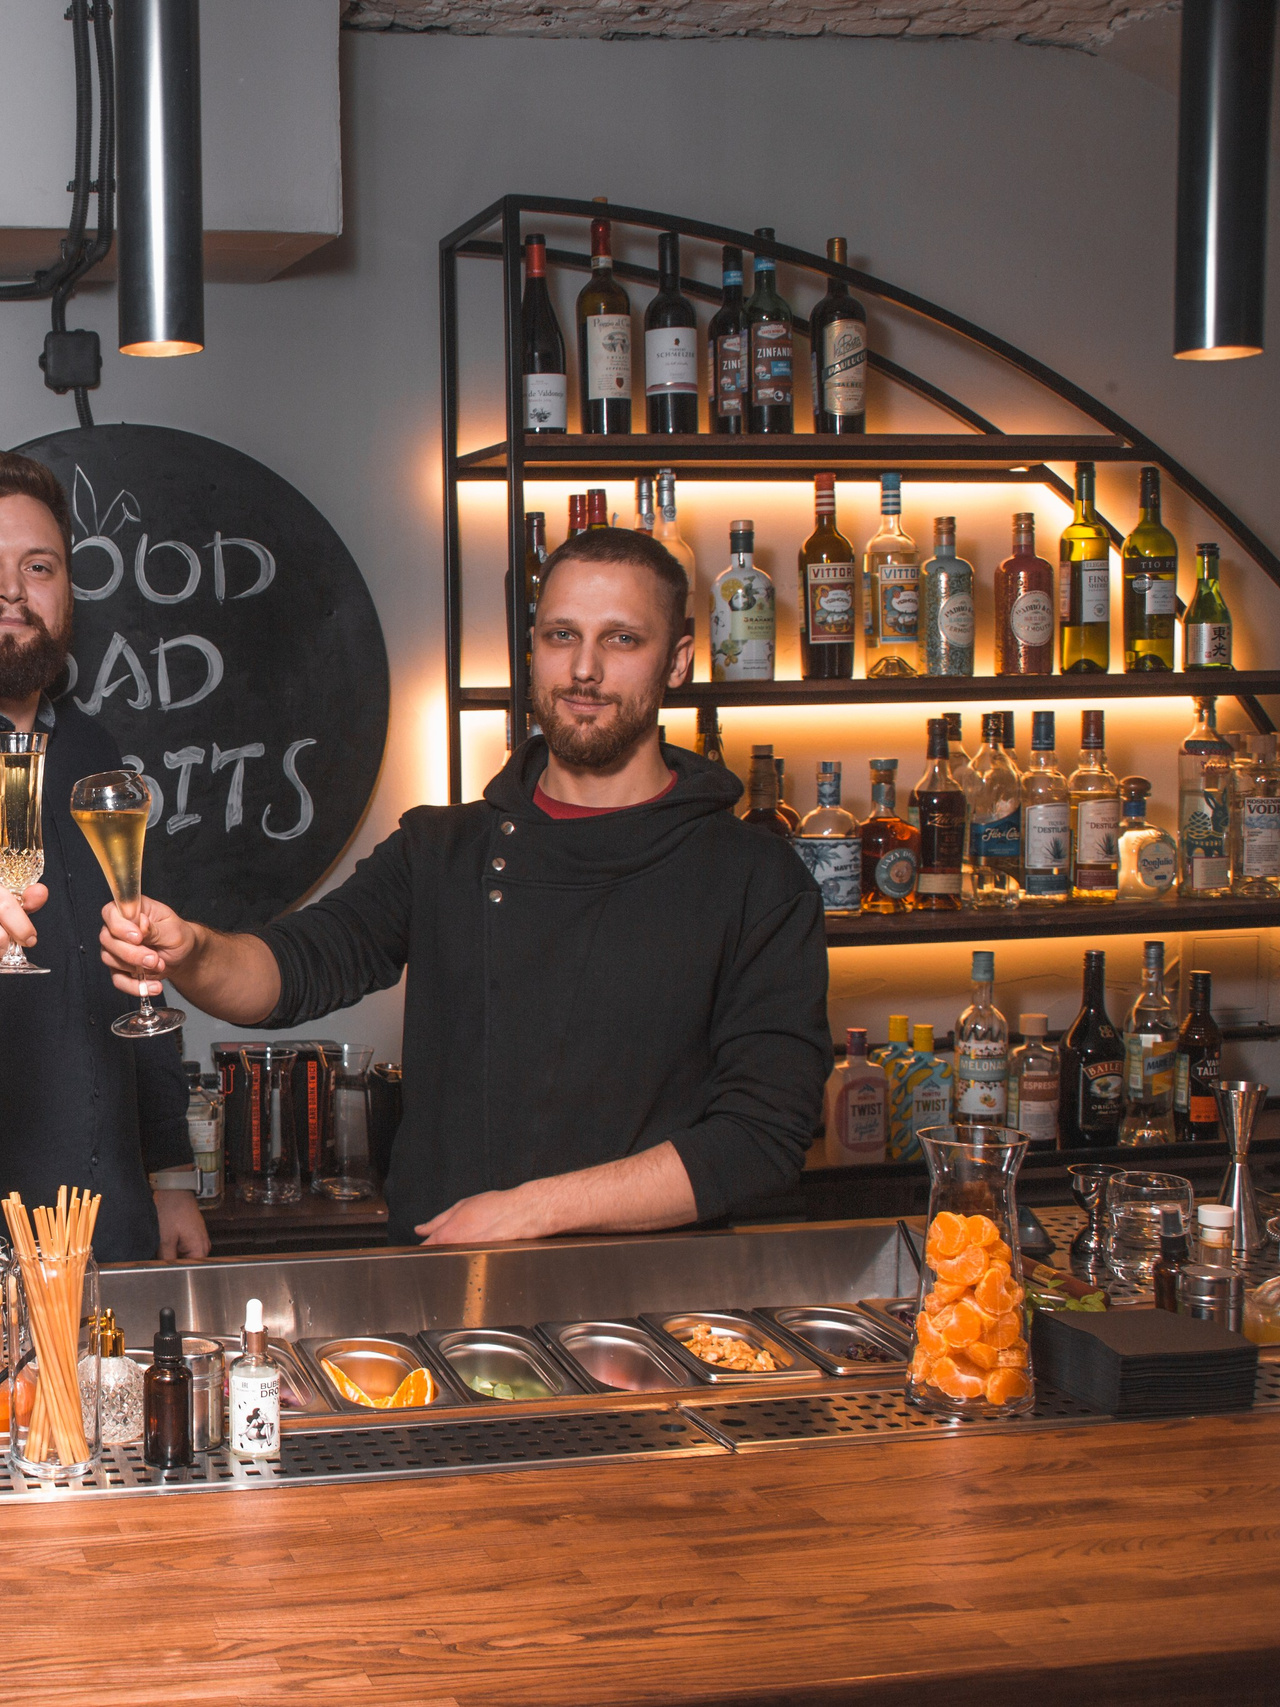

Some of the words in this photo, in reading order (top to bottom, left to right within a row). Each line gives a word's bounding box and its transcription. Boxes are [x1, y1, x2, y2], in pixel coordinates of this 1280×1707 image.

[71, 531, 276, 605] OOD
[1140, 561, 1161, 569] TIO
[880, 851, 901, 870] LAZY
[850, 1102, 882, 1117] TWIST
[915, 1098, 947, 1112] TWIST
